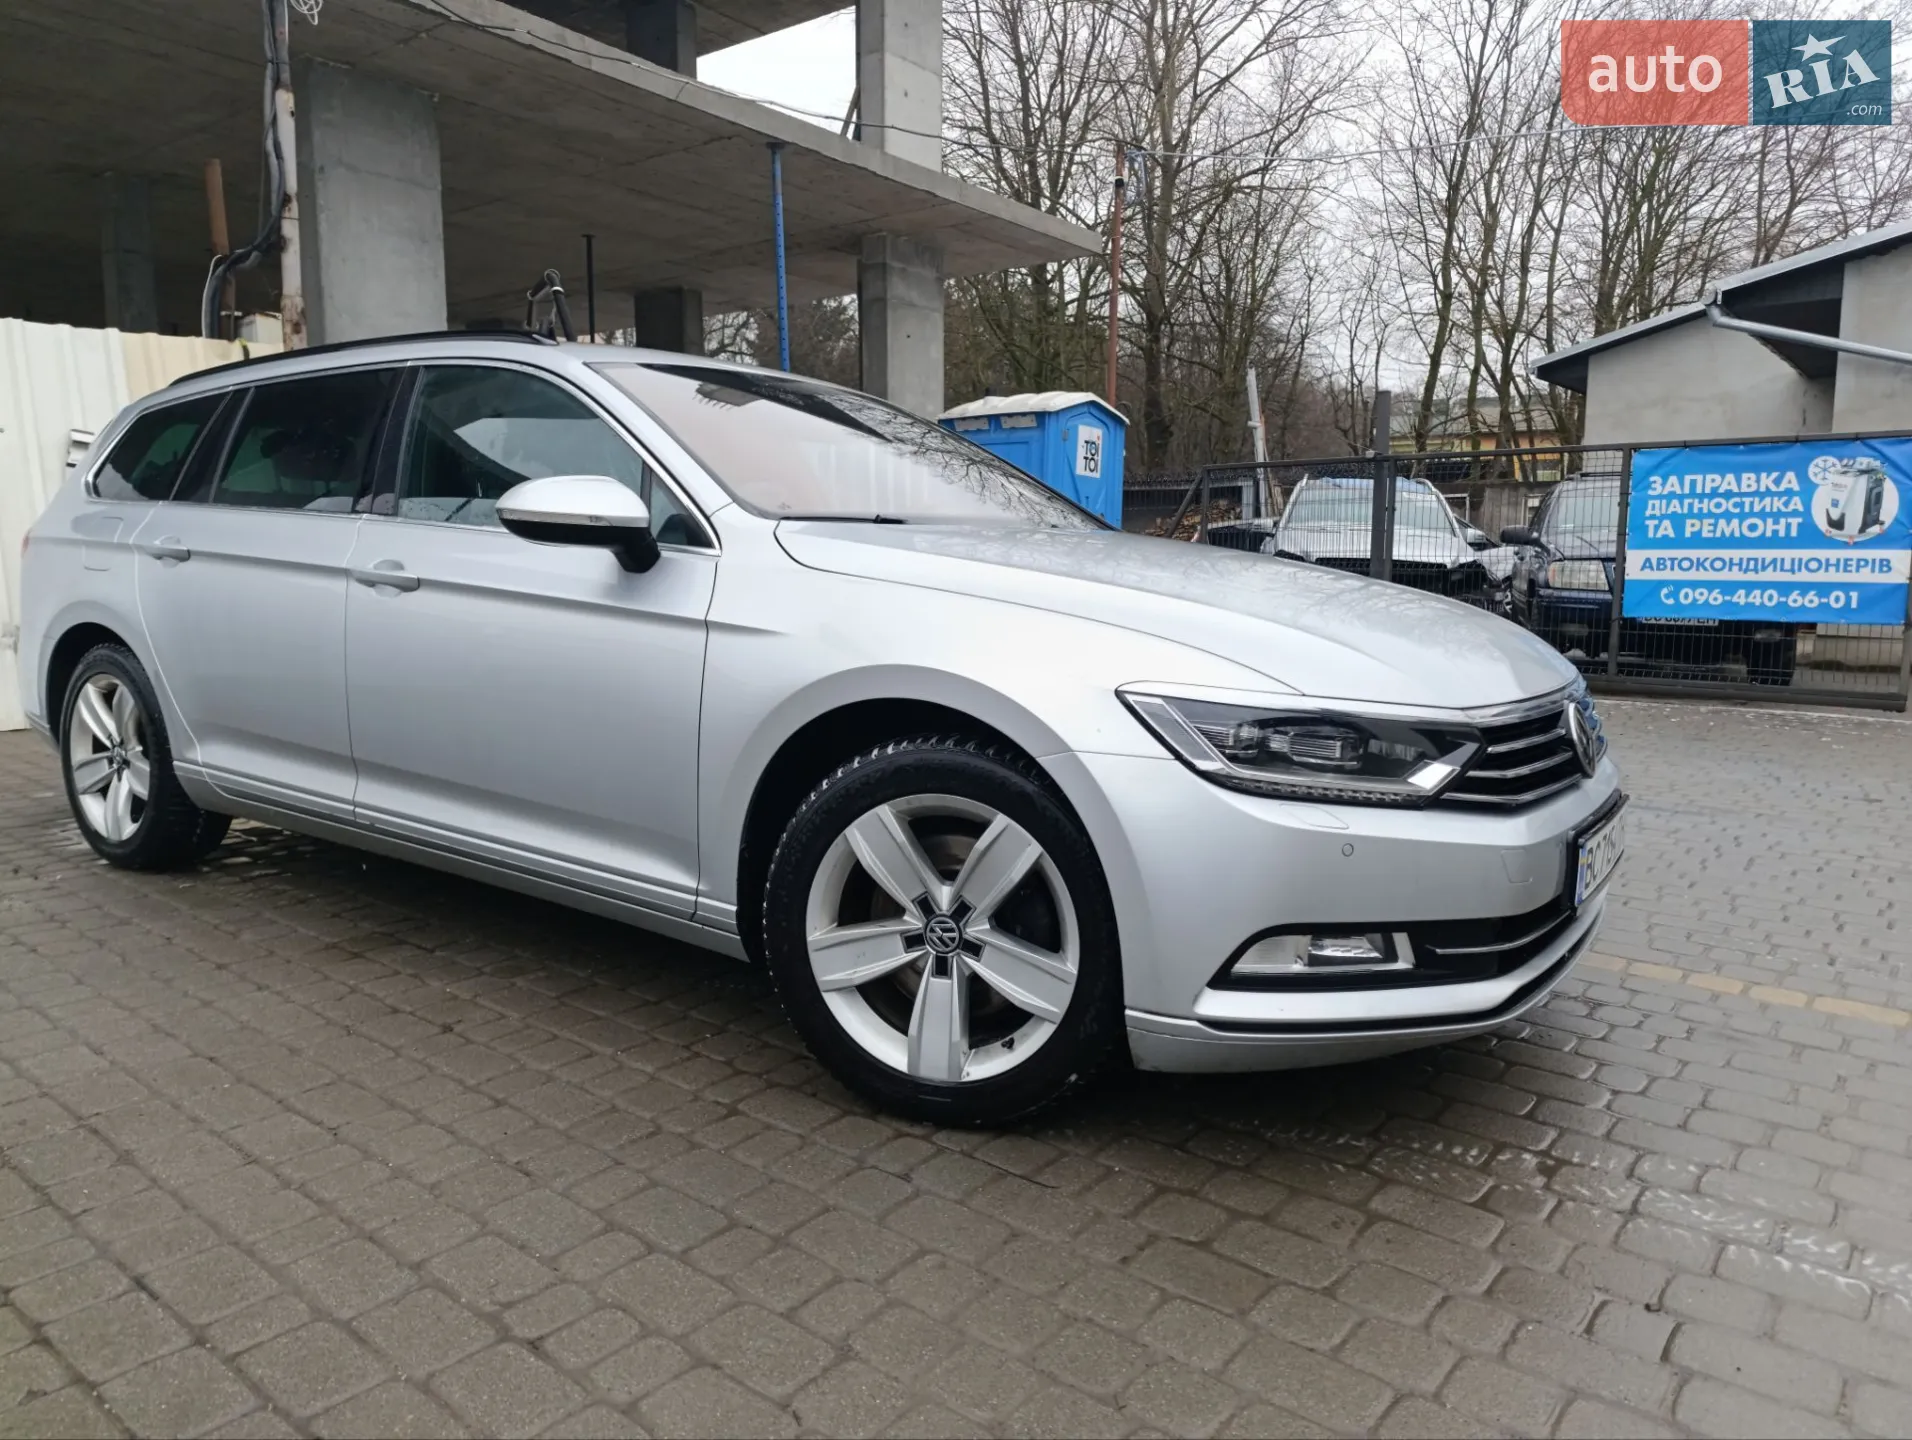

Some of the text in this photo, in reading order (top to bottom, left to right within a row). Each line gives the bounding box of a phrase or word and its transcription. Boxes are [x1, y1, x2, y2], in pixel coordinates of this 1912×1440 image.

[1647, 471, 1800, 496] ЗАПРАВКА
[1645, 496, 1804, 517] ДІАГНОСТИКА
[1645, 517, 1803, 539] ТА РЕМОНТ
[1640, 556, 1893, 575] АВТОКОНДИЦІОНЕРІВ
[1679, 587, 1859, 609] 096-440-66-01
